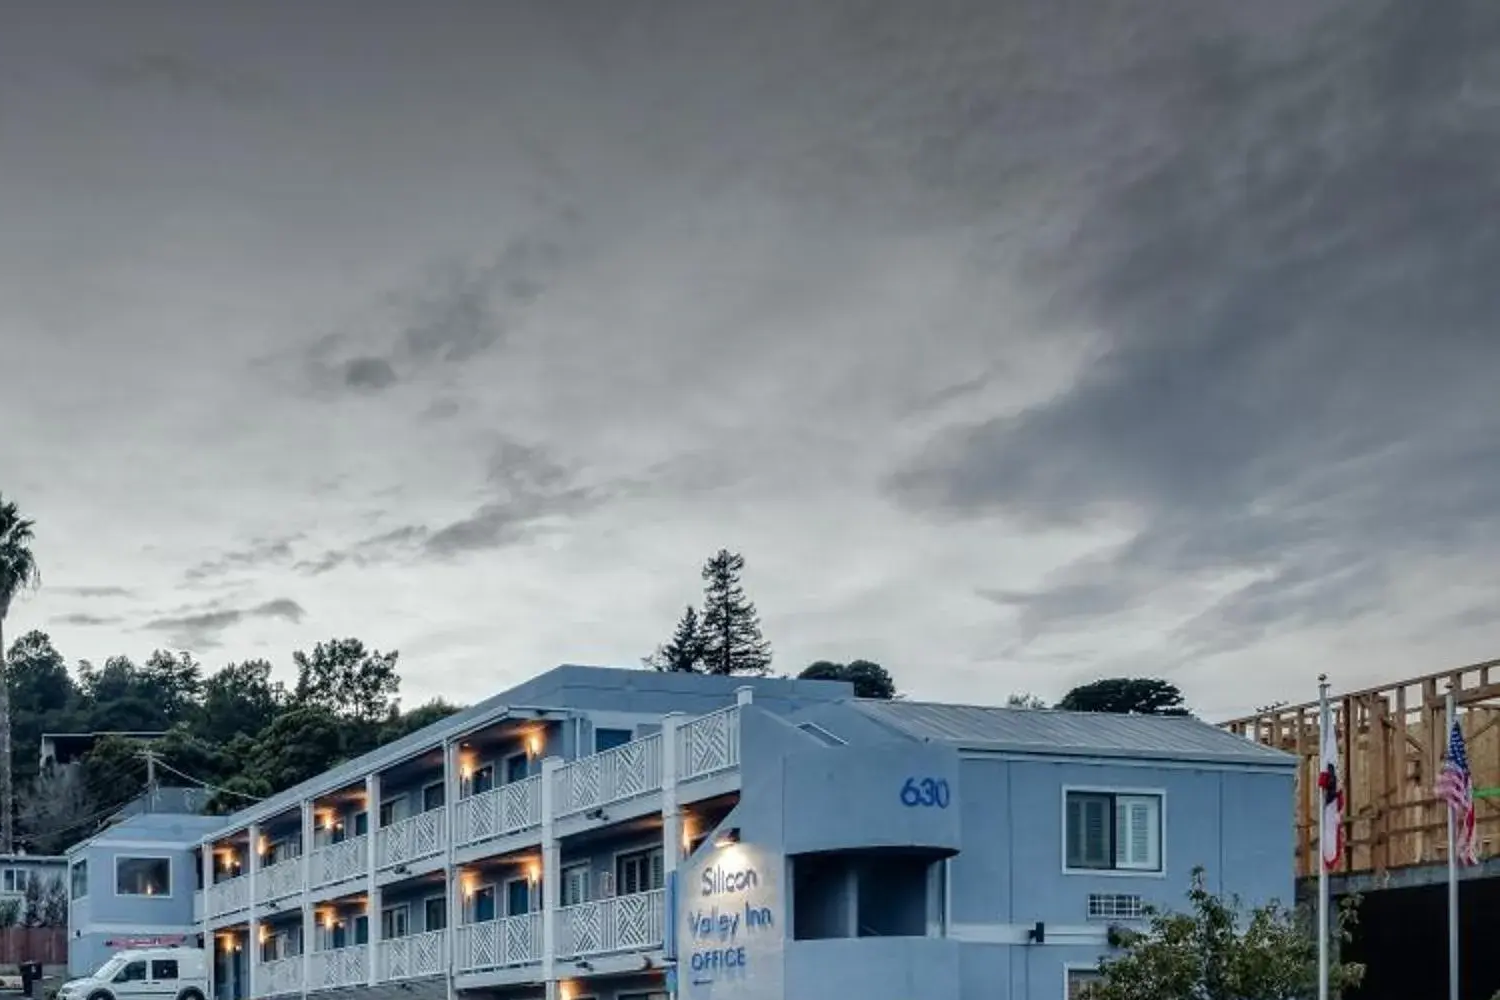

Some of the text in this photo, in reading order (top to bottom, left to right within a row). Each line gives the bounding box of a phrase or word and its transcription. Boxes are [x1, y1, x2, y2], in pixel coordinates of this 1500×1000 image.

[900, 777, 950, 809] 630
[702, 866, 758, 896] Silicon
[690, 902, 772, 940] Valley Inn
[691, 947, 746, 971] OFFICE
